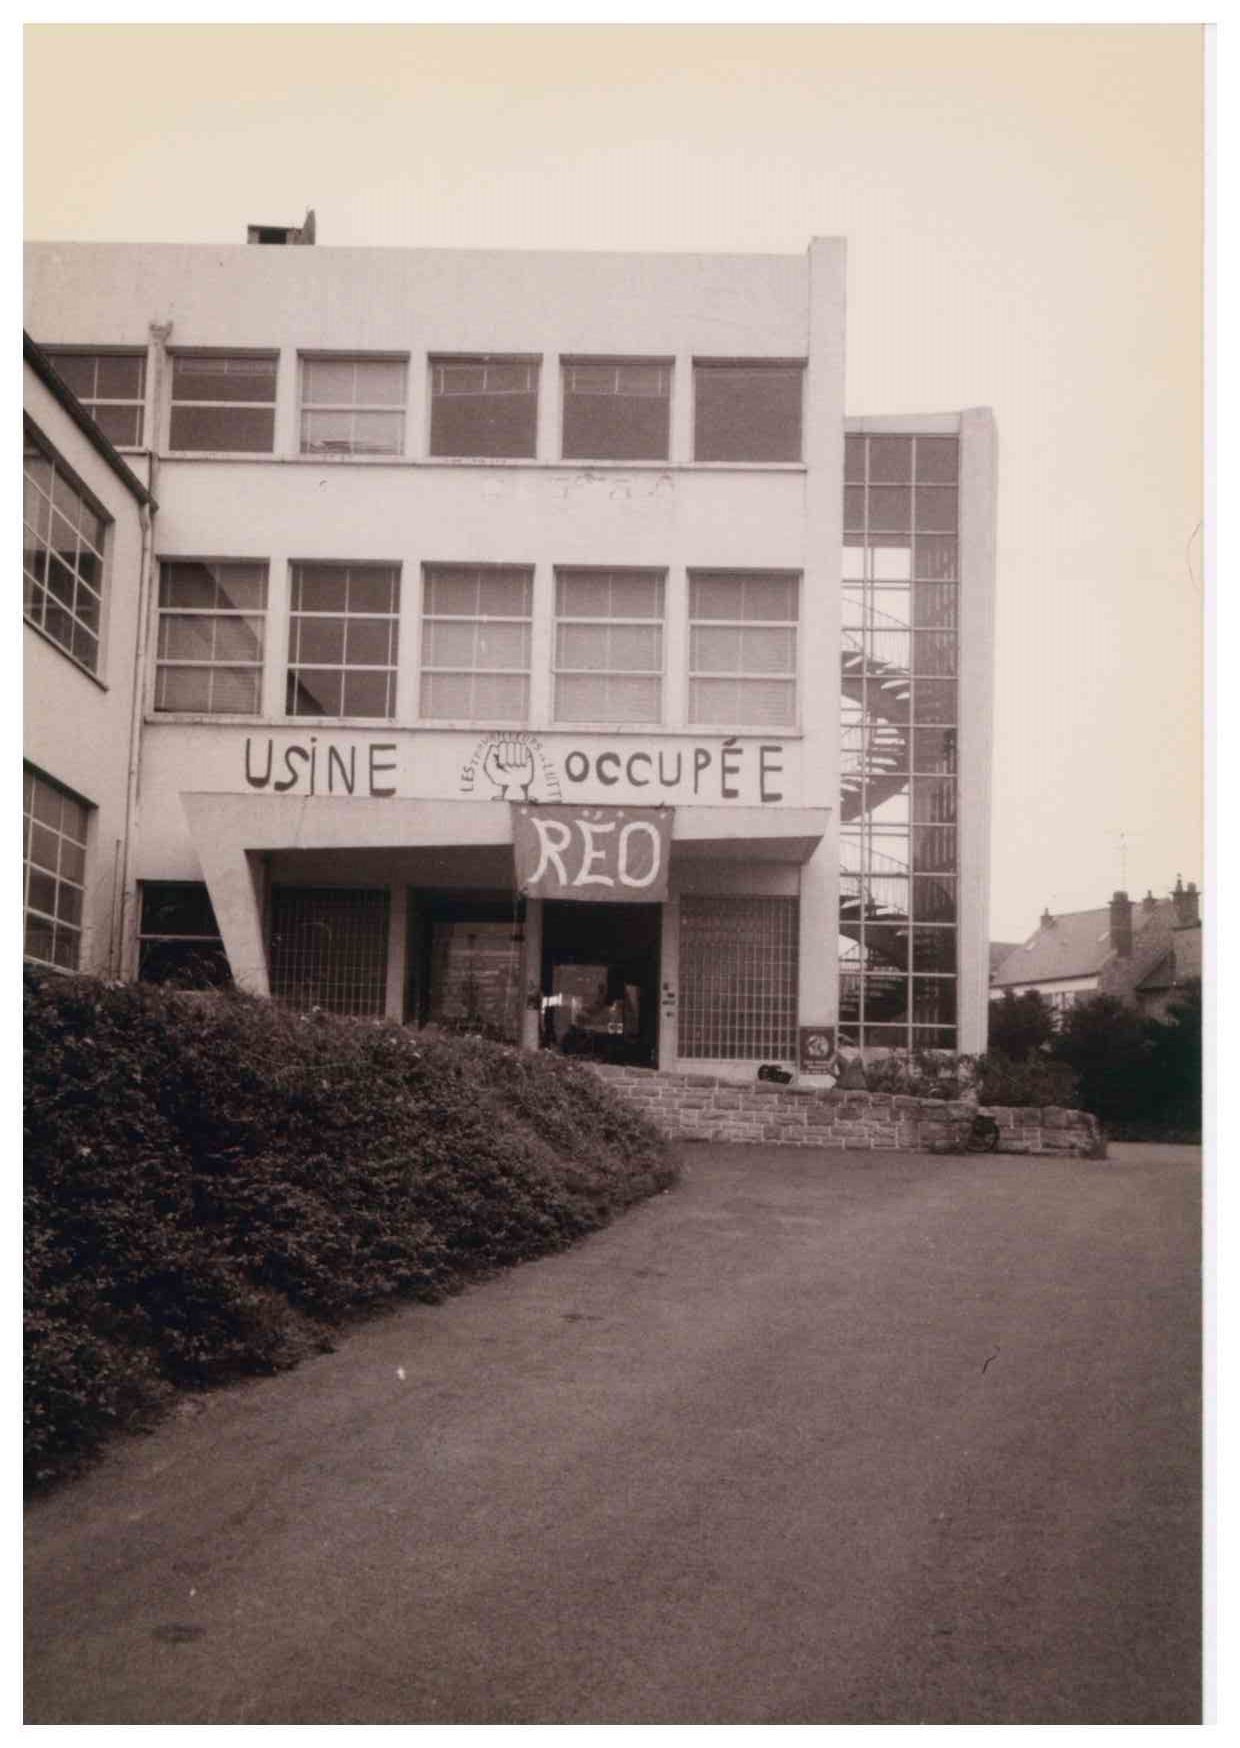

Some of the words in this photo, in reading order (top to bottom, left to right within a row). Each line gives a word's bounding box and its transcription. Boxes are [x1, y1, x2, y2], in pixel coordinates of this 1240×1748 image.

[460, 766, 475, 792] LES
[565, 737, 783, 802] OCCUPÉE
[525, 811, 660, 888] RÉO
